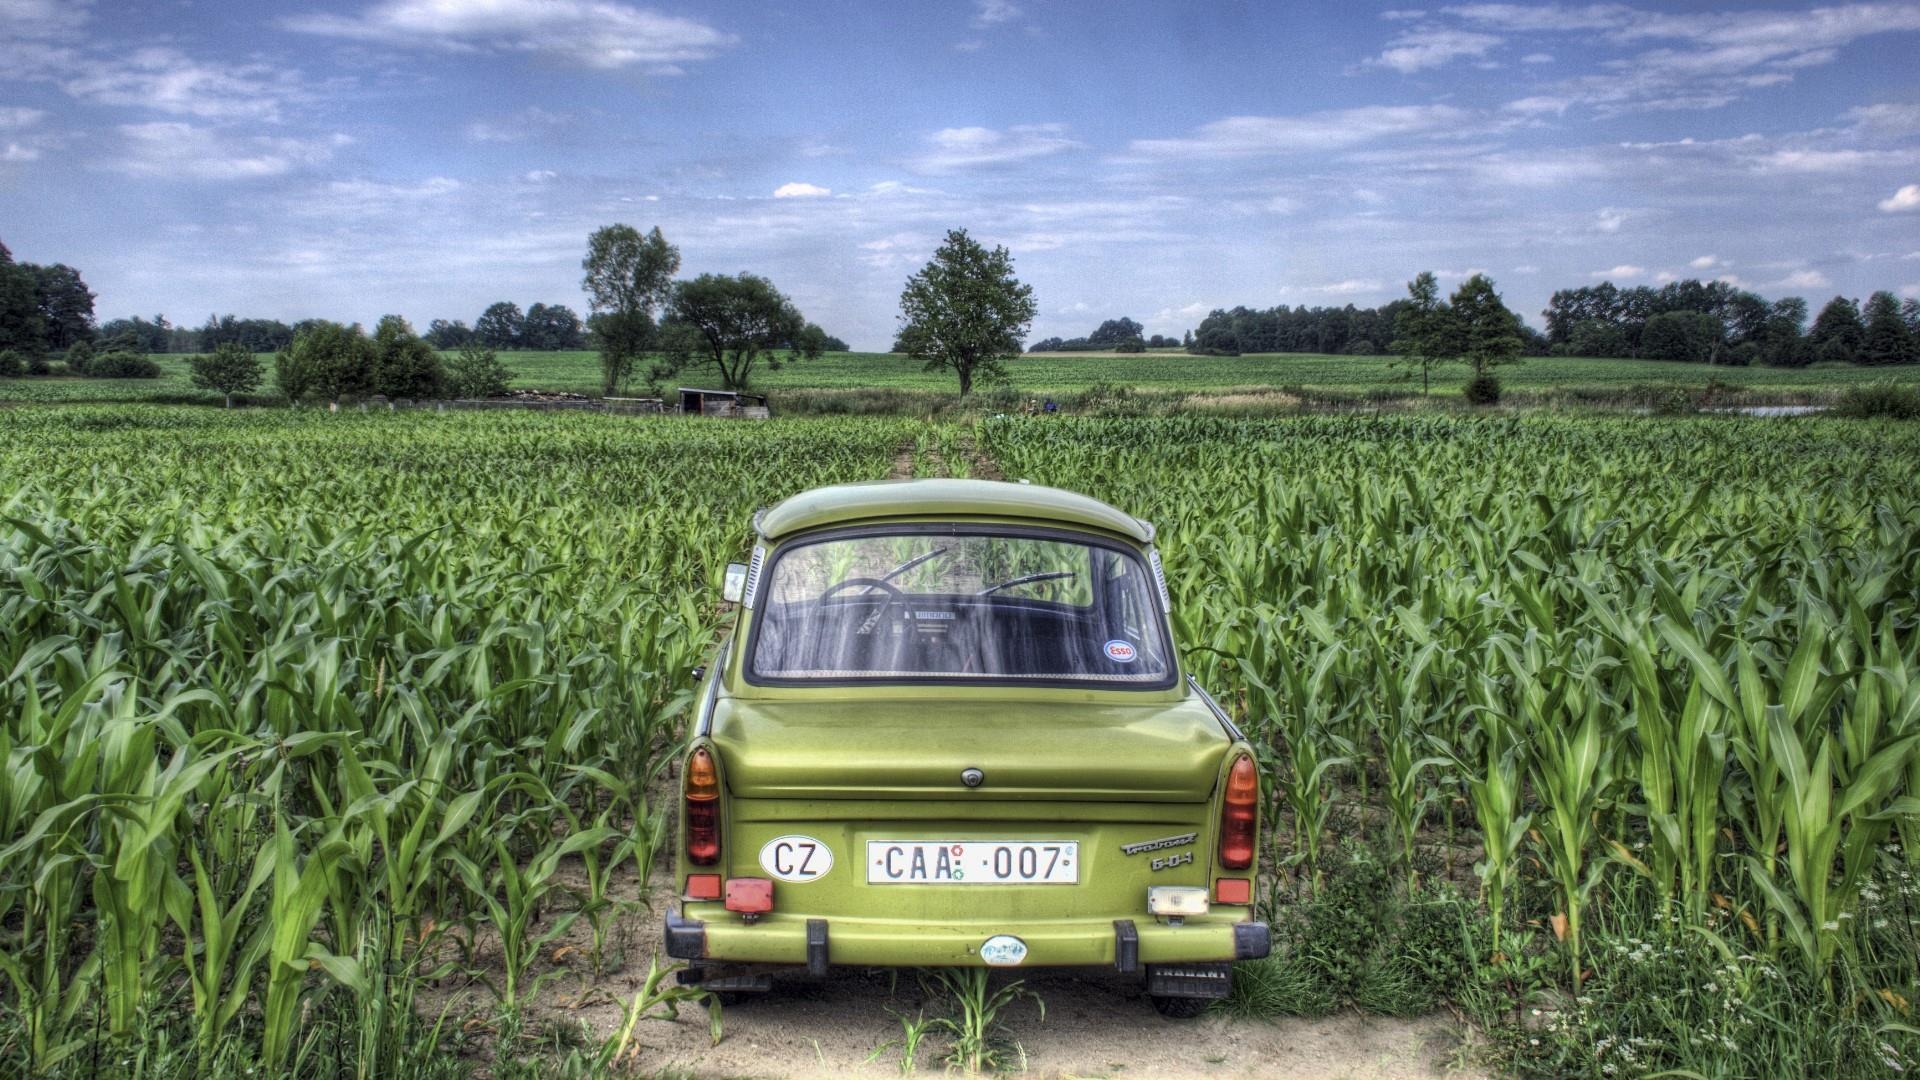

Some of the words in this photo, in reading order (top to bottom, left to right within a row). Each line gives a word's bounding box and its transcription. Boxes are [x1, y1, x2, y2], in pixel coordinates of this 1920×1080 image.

[774, 842, 817, 875] CZ
[886, 846, 951, 879] CAA
[994, 846, 1060, 879] 007
